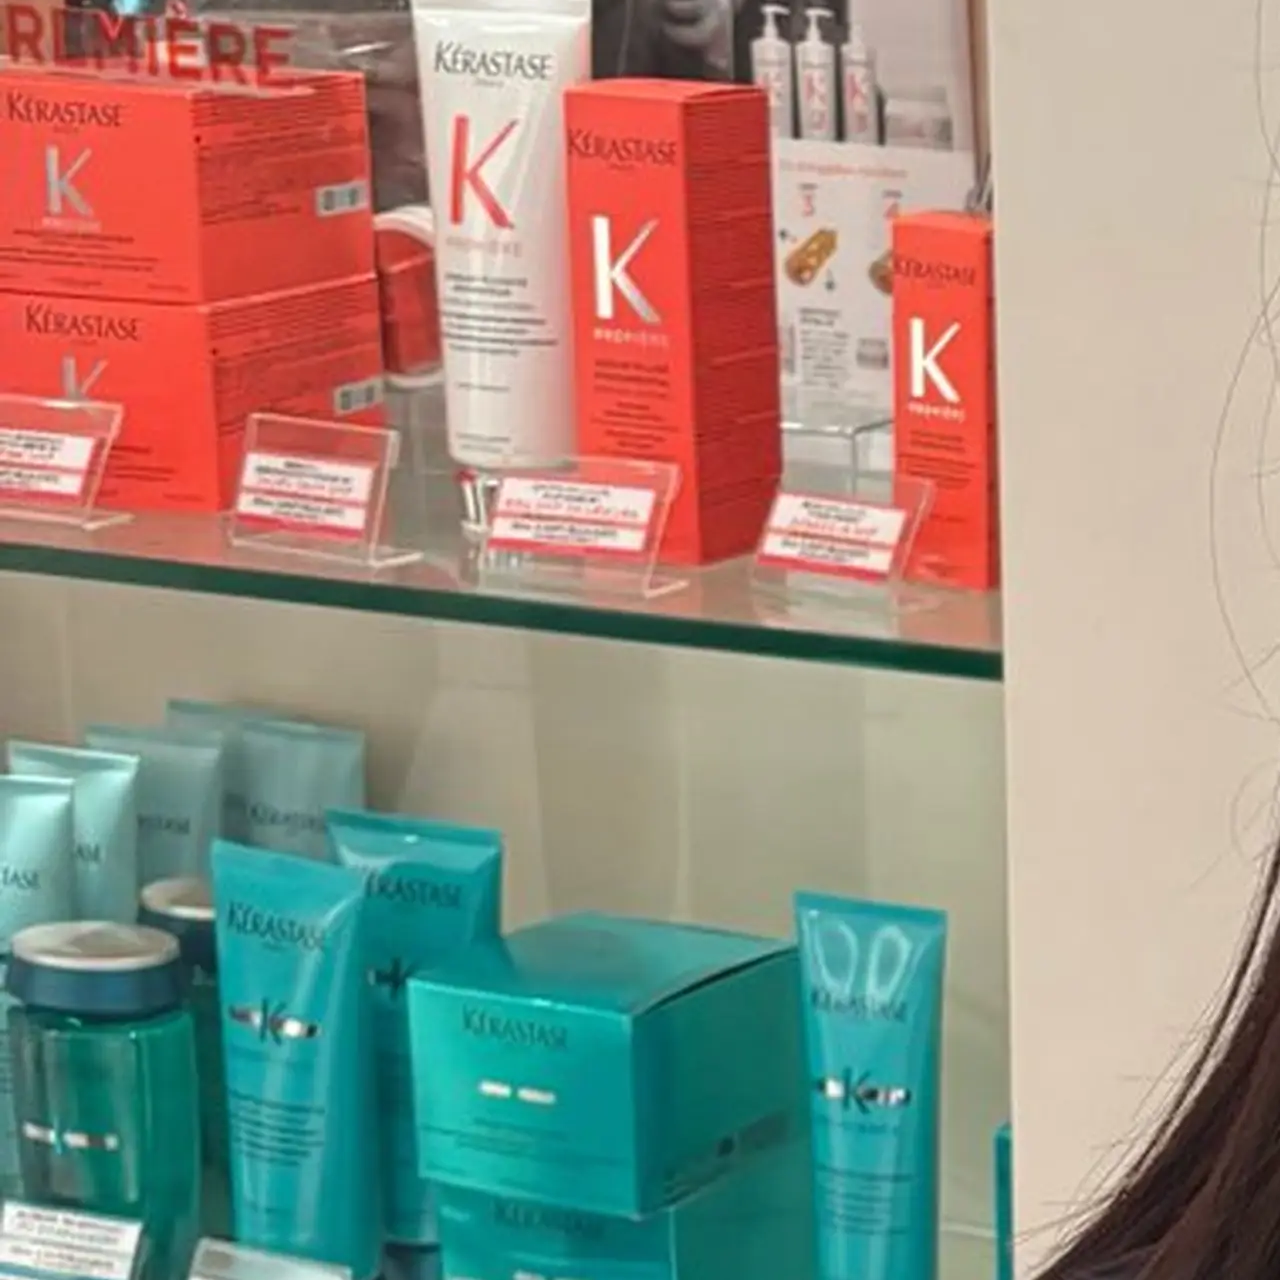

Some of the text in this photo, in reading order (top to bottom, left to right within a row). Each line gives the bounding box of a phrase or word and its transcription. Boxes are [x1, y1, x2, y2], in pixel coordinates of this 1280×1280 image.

[433, 40, 554, 81] KÉRASTASE
[6, 89, 123, 127] KÉRASTASE
[450, 114, 520, 229] K
[567, 128, 679, 166] KÉRASTASE
[46, 144, 93, 216] K
[593, 214, 661, 325] K
[25, 303, 142, 342] KÉRASTASE
[910, 316, 961, 403] K
